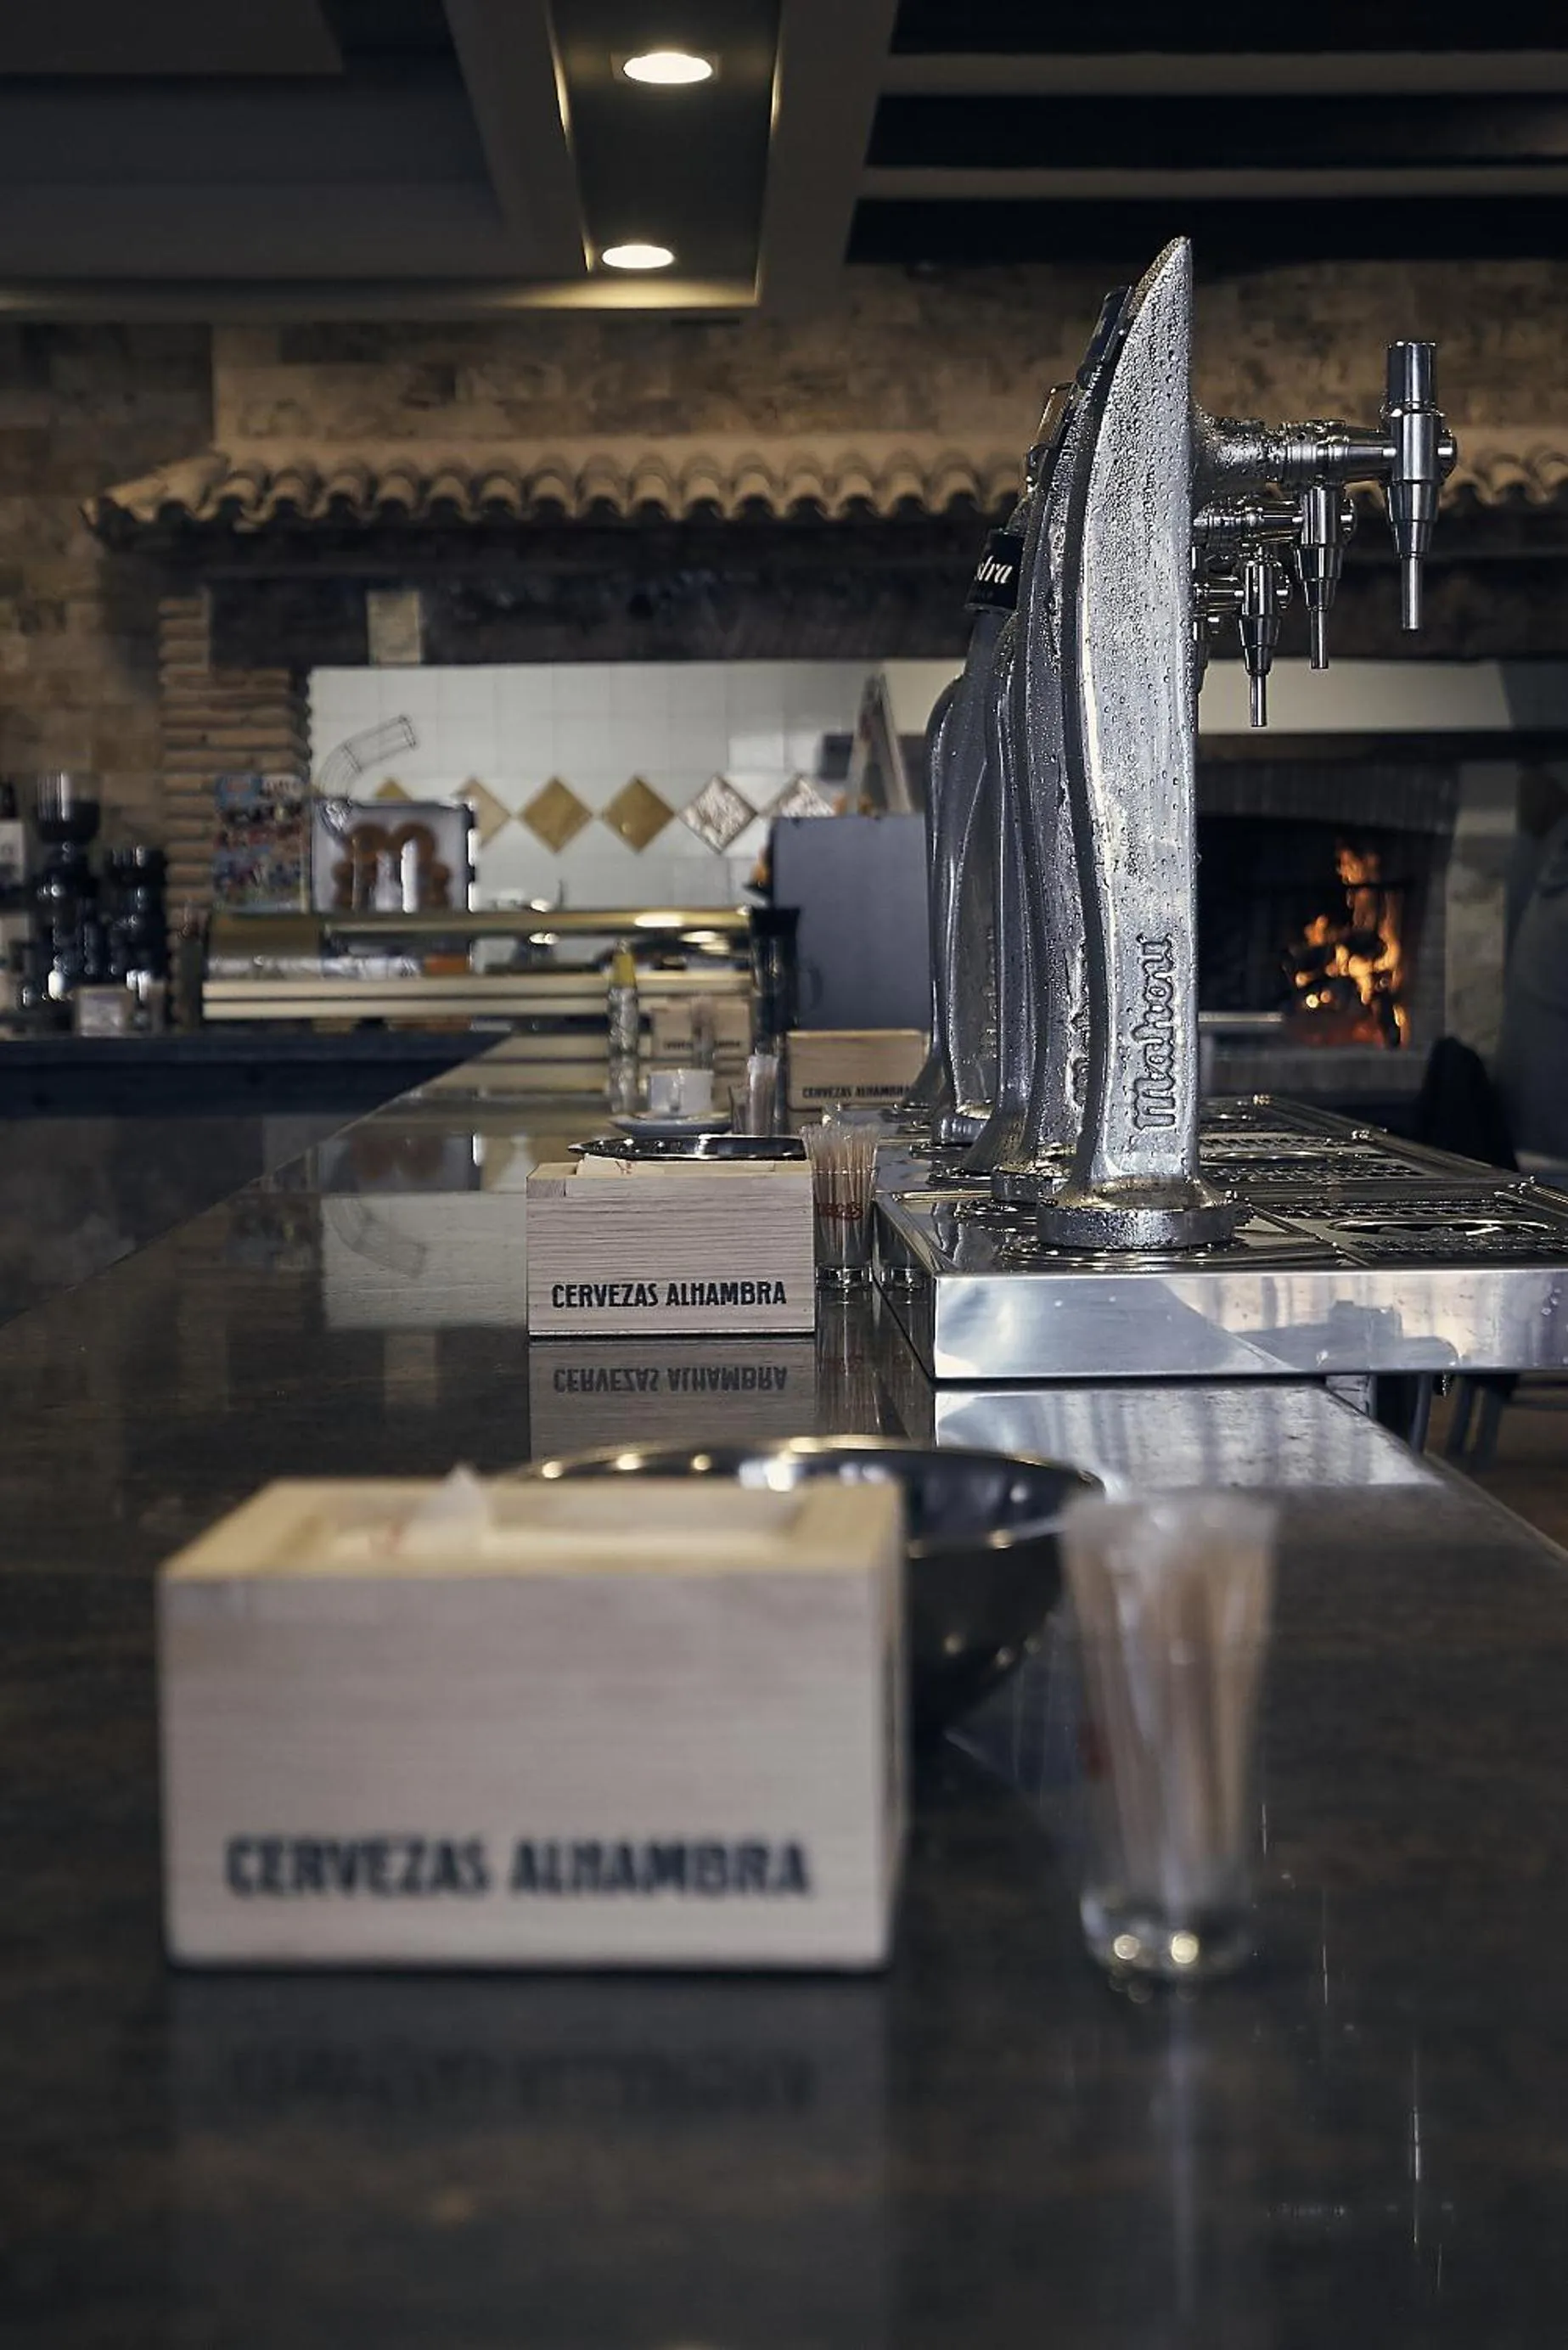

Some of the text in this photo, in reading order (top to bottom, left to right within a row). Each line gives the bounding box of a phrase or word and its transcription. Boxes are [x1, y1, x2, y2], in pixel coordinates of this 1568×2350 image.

[974, 554, 1013, 584] dra
[1131, 933, 1176, 1131] Mahou
[551, 1280, 787, 1309] CERVEZAS ALHAMBRA
[224, 1835, 811, 1897] CERVEZAS ALHAMBRA
